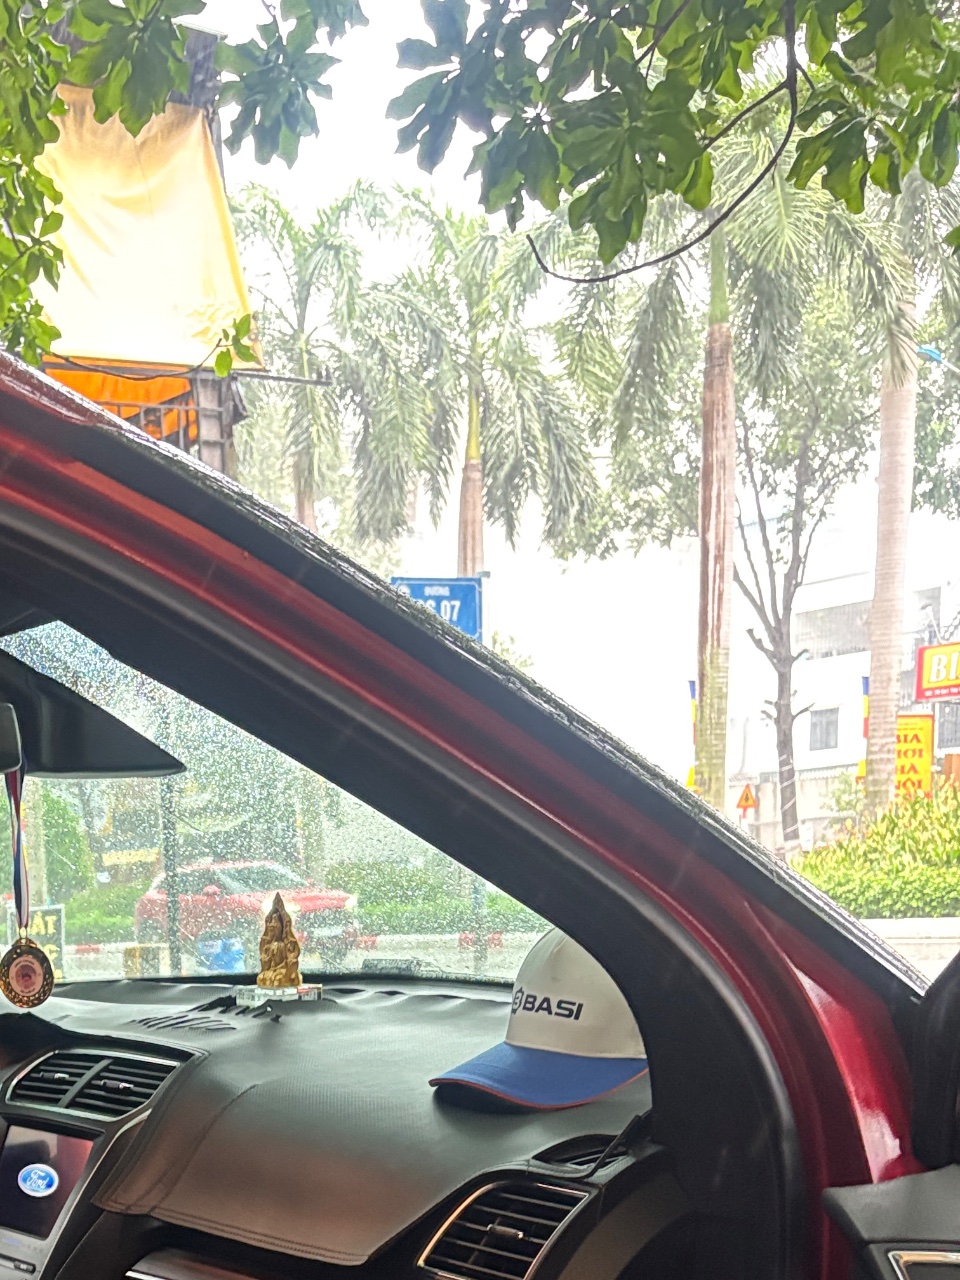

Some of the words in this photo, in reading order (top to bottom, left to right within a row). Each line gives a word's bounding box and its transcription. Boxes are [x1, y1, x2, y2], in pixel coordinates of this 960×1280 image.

[440, 599, 461, 622] 07
[928, 651, 960, 684] BI
[522, 994, 584, 1021] BASI
[26, 1169, 50, 1190] Ford
